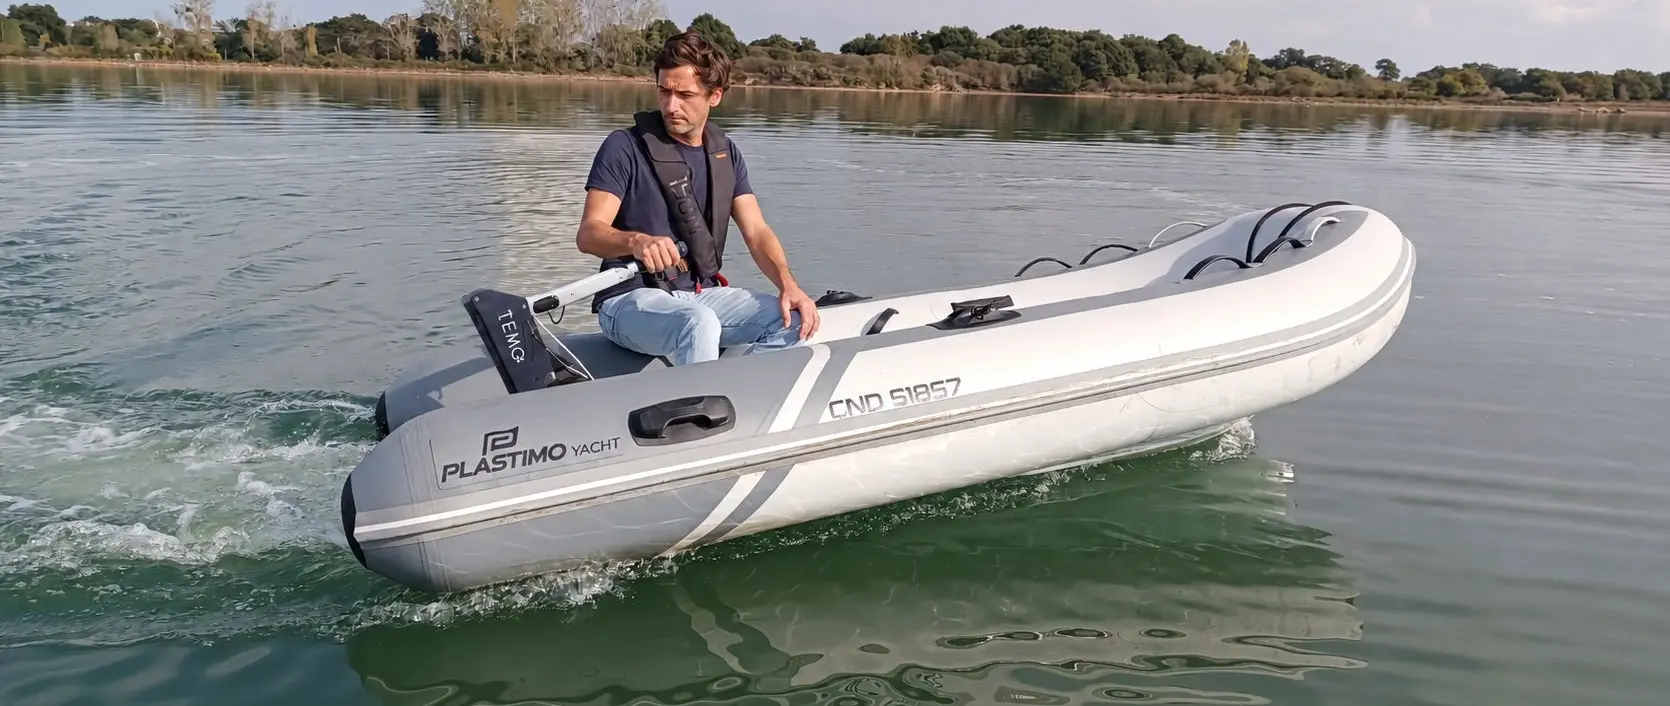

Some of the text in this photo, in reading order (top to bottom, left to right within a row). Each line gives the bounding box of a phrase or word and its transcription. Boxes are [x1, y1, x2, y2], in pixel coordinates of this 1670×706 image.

[828, 376, 961, 419] CND 51857
[441, 437, 621, 483] PLASTIMO YACHT
